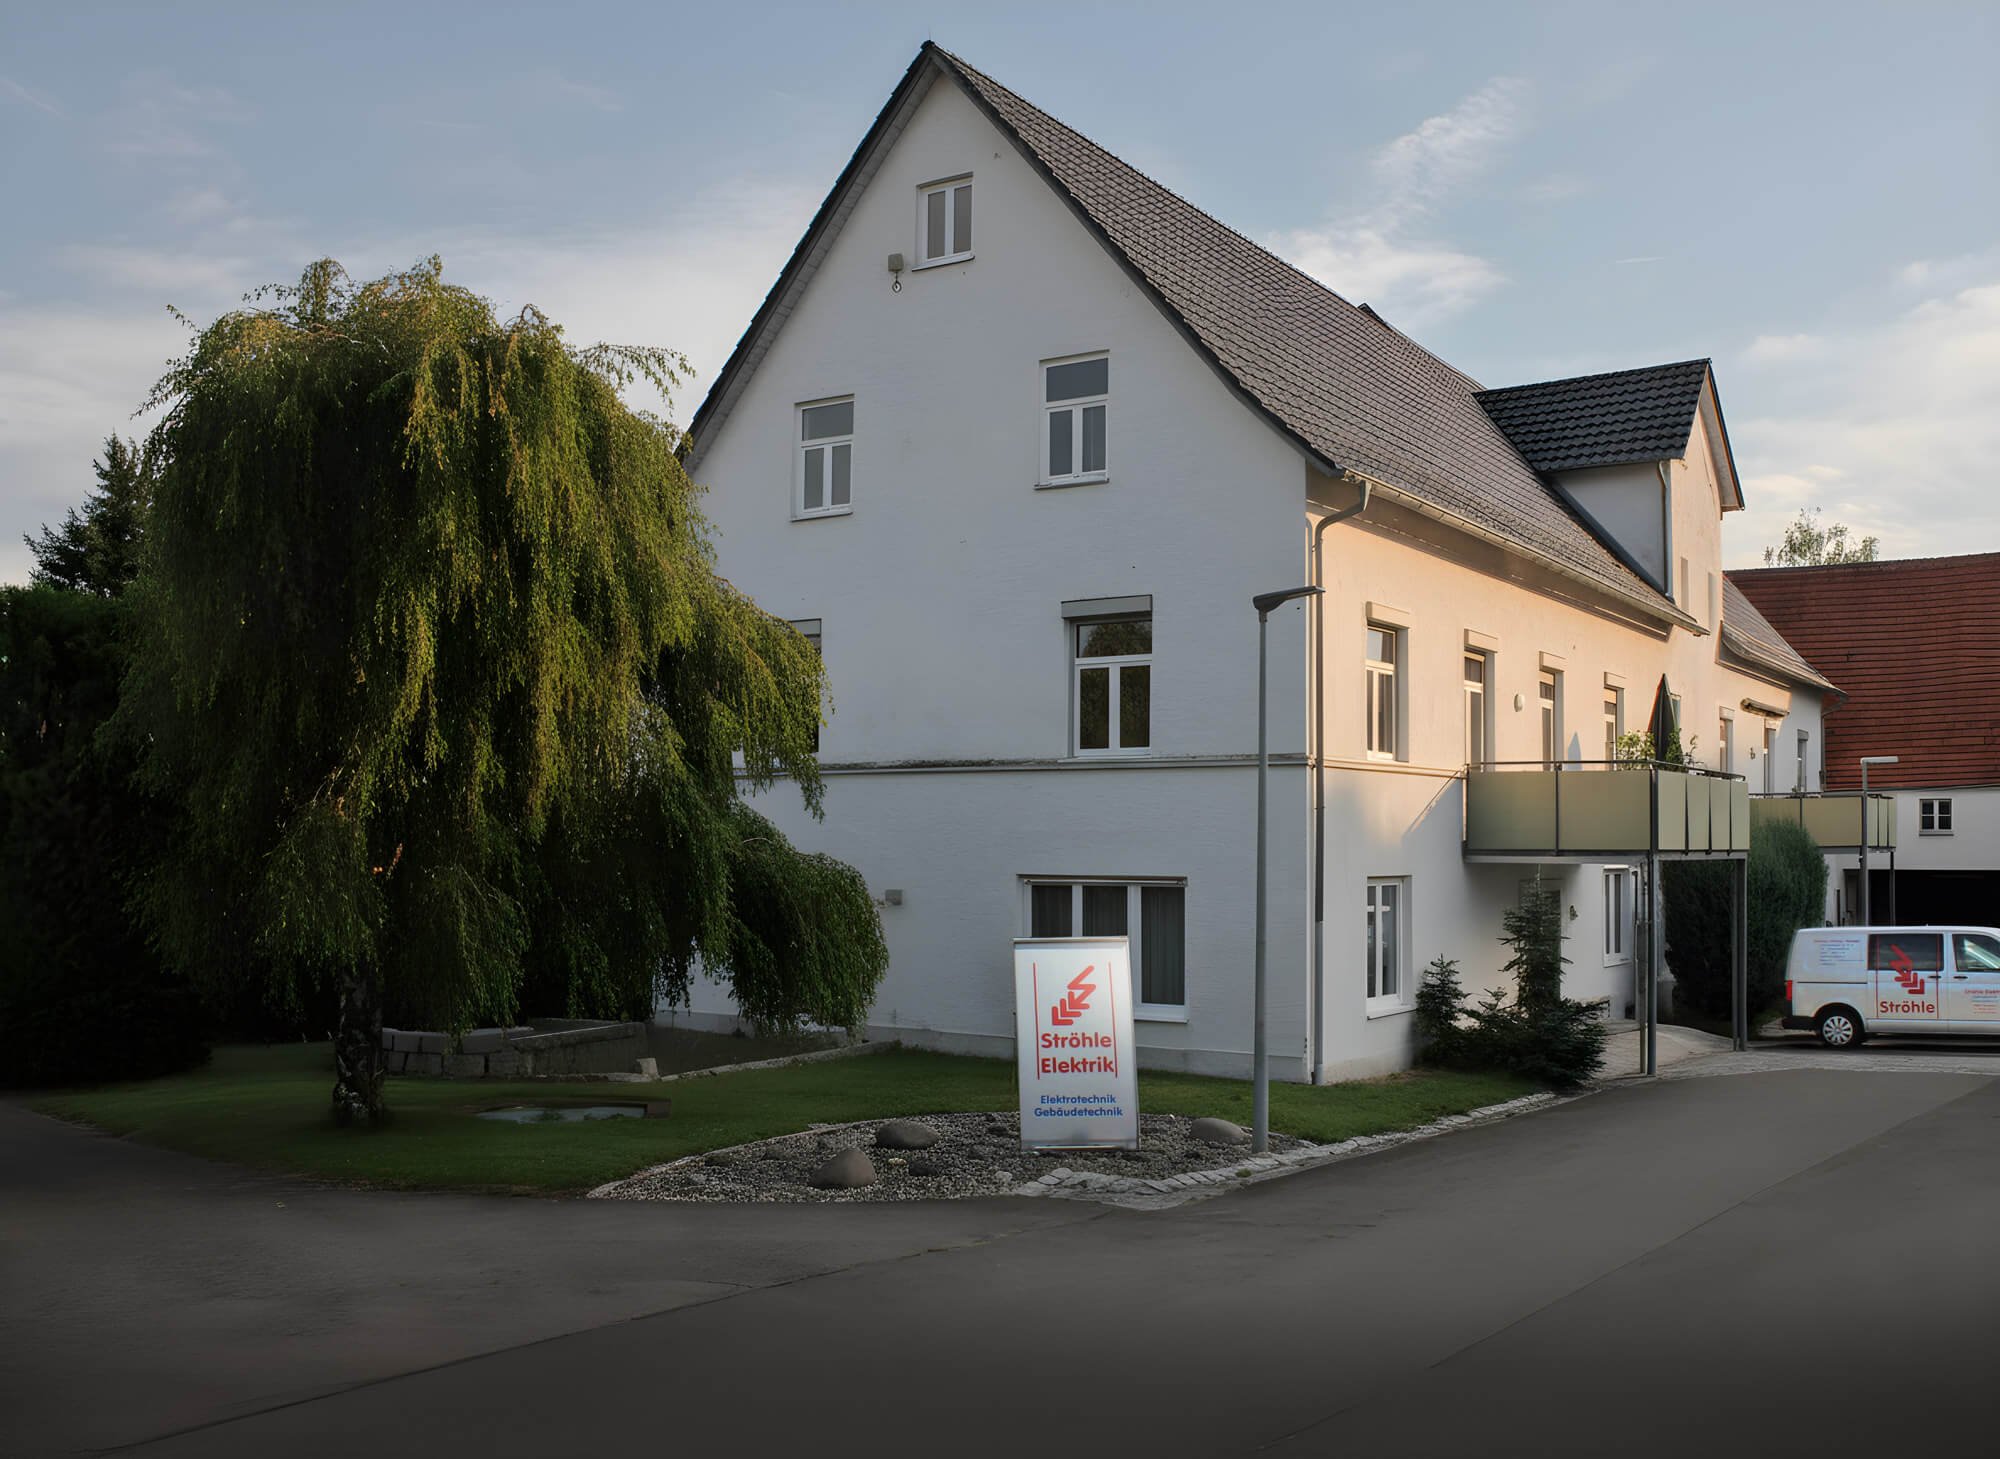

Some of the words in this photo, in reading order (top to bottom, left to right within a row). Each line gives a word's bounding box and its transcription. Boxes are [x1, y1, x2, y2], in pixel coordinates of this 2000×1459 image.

[1879, 1001, 1935, 1014] Ströhle
[1041, 1032, 1112, 1049] Ströhle
[1041, 1057, 1115, 1073] Elektrik
[1040, 1094, 1116, 1104] Elektrotechnik
[1034, 1107, 1123, 1118] Gebäudetechnik
